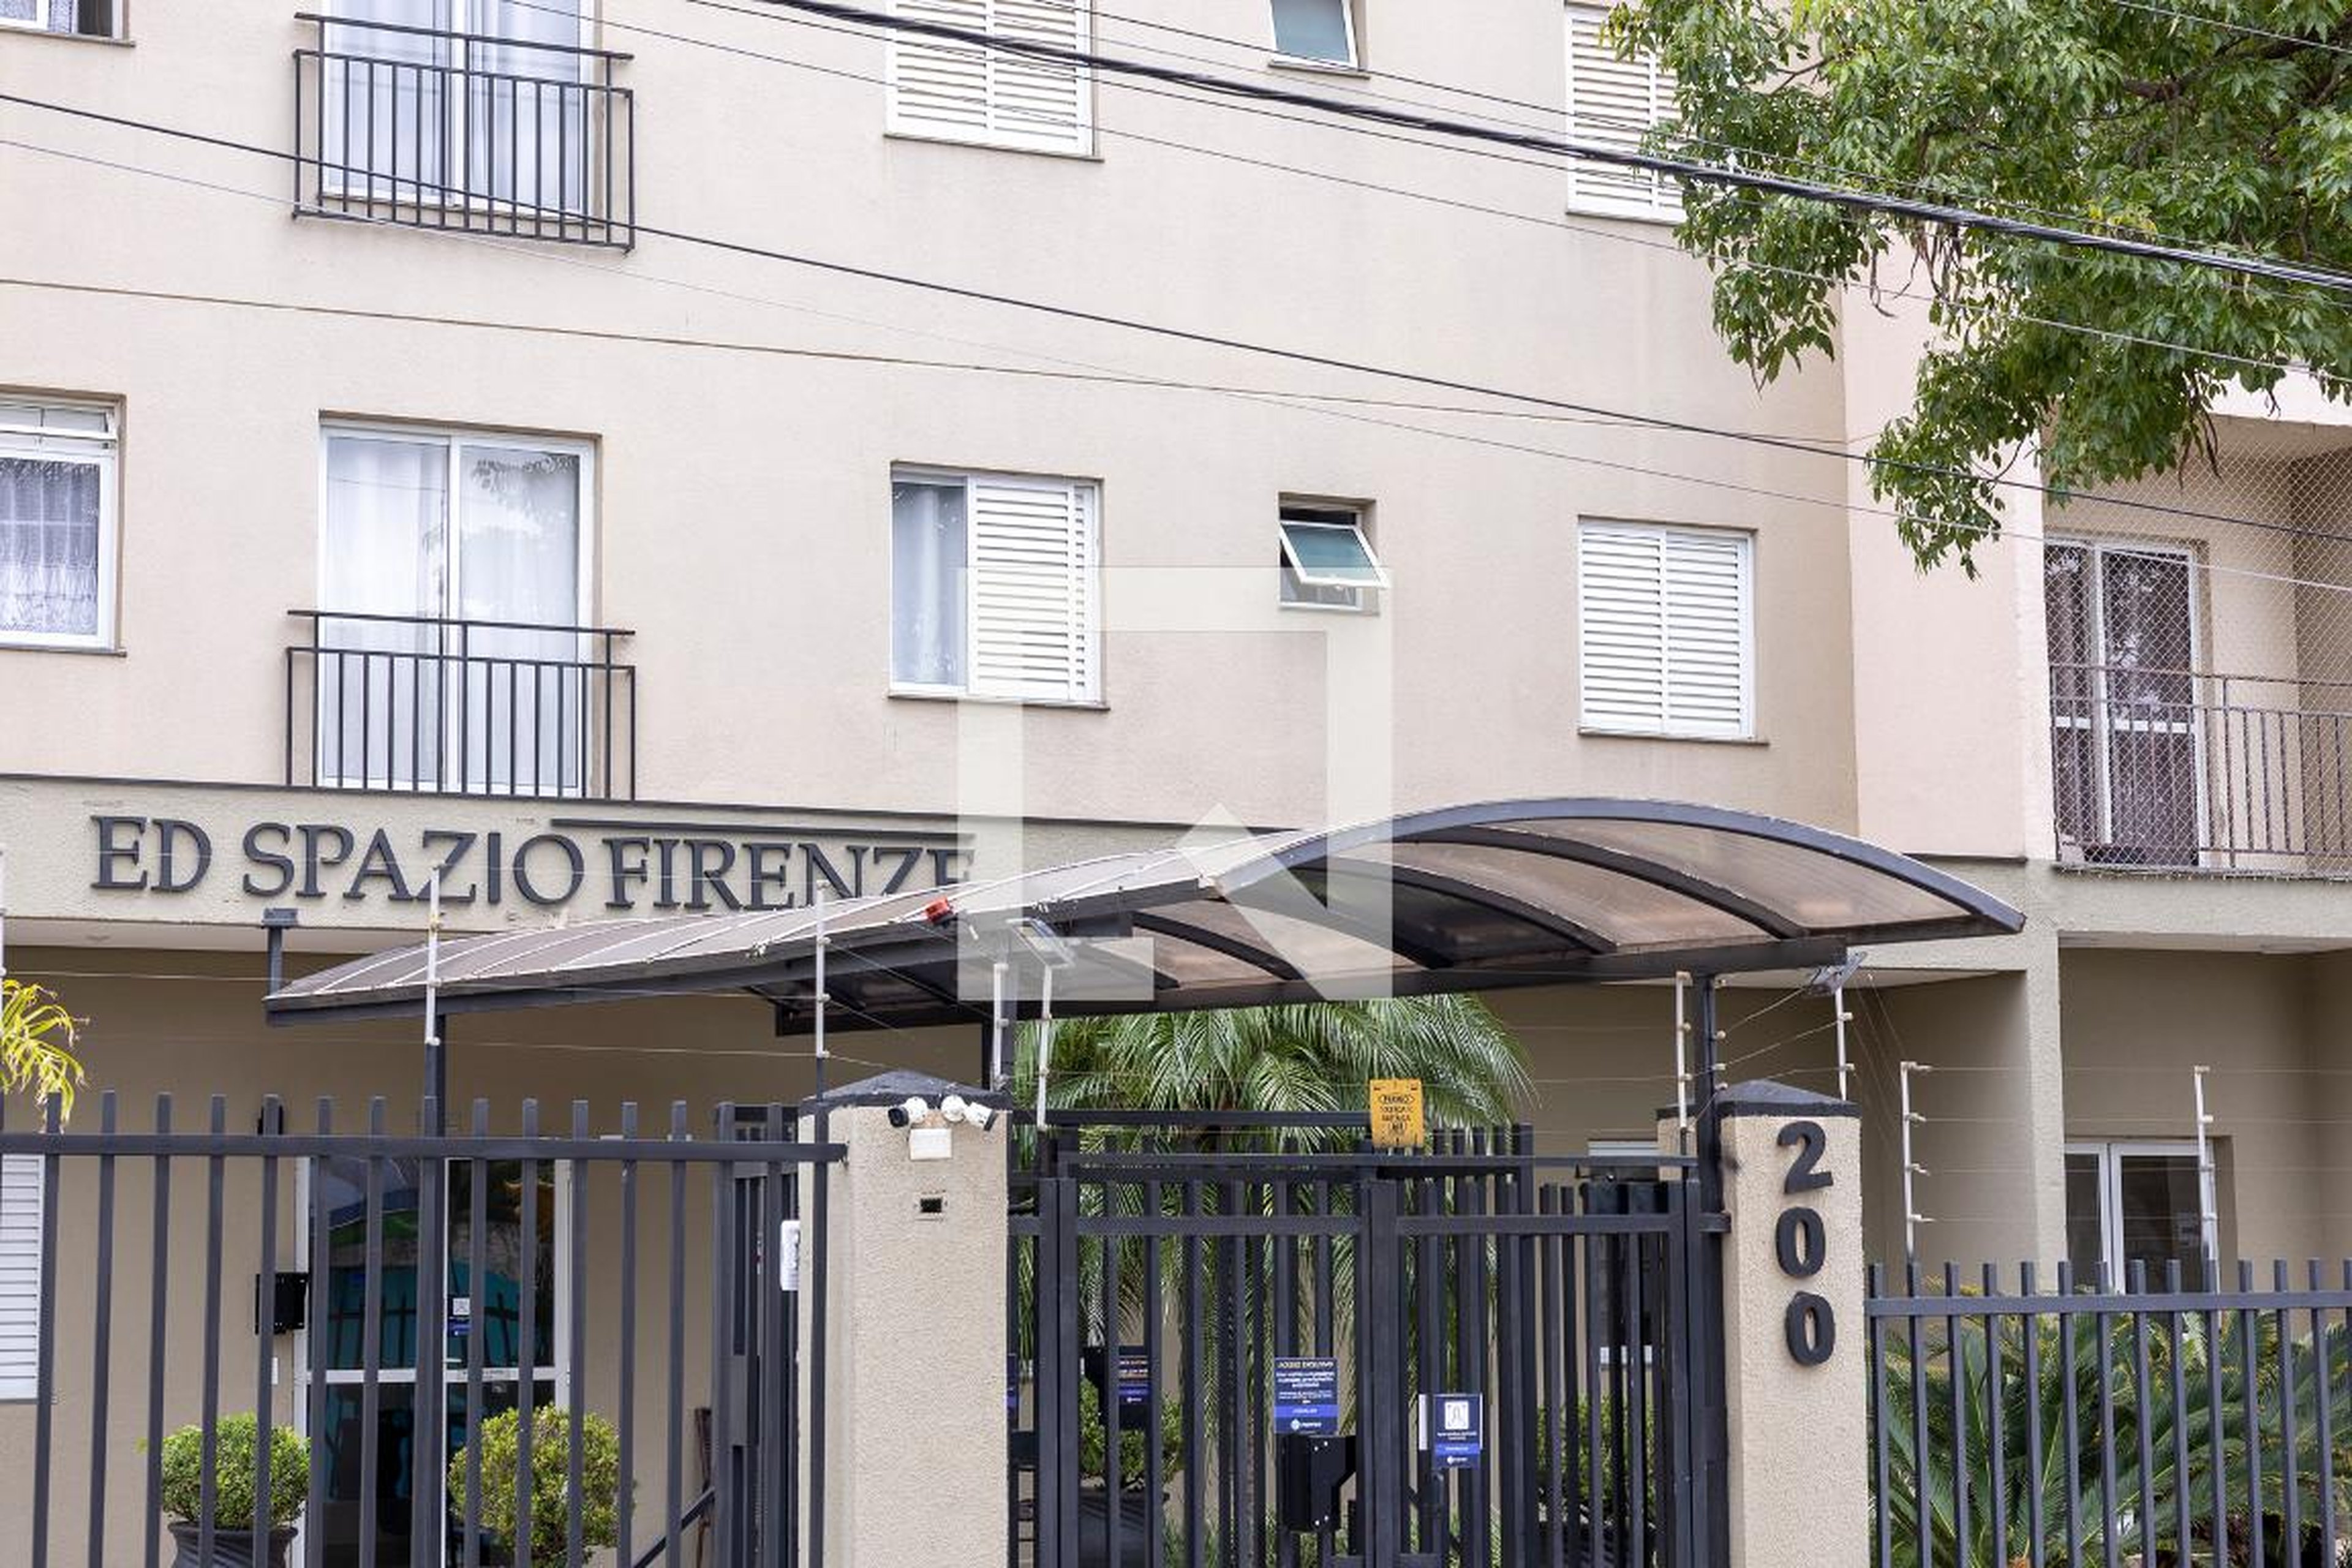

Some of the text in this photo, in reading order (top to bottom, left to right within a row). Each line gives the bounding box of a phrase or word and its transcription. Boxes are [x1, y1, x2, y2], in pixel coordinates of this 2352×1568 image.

[90, 815, 212, 894] ED
[243, 822, 584, 905] SPAZIO
[1776, 1120, 1834, 1368] 200
